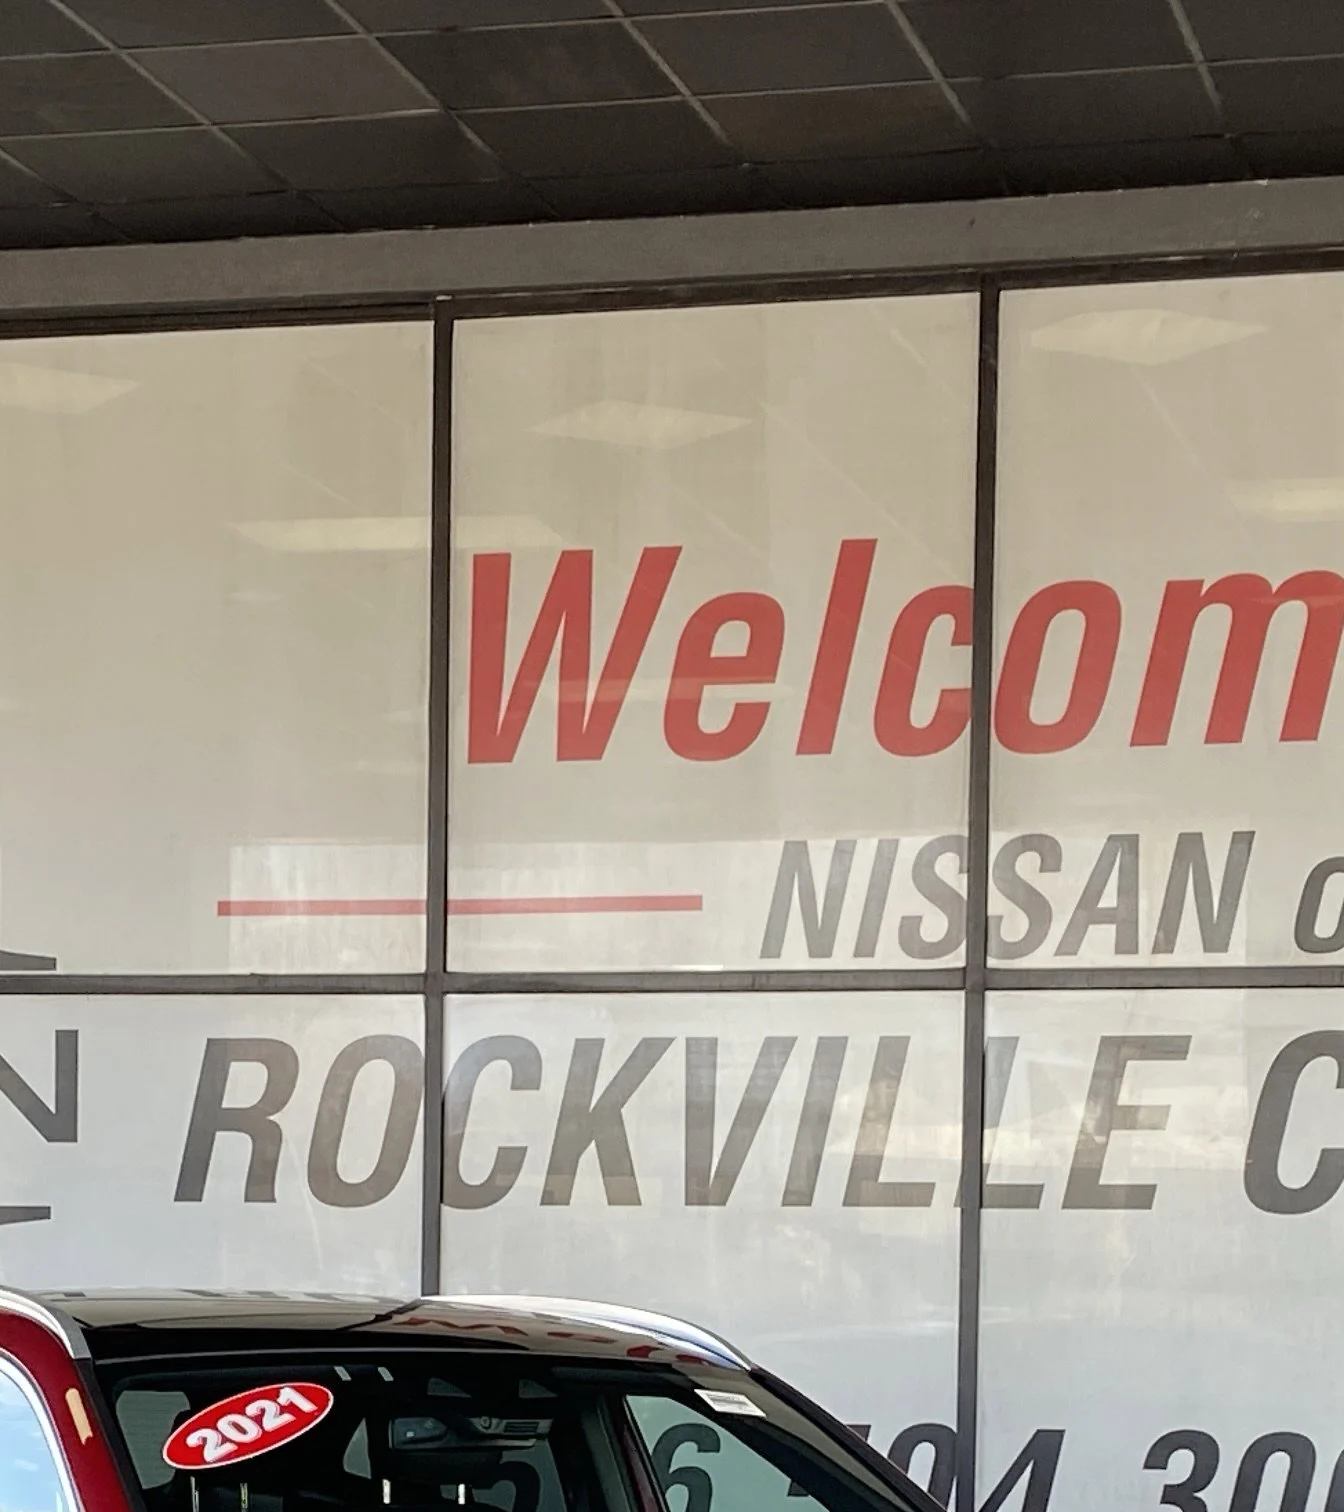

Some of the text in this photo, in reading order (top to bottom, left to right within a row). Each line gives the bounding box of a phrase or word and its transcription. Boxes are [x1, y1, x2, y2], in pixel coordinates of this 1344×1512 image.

[760, 831, 1254, 960] NISSAN
[173, 1034, 1190, 1211] ROCKVILLE
[186, 1386, 317, 1462] 2021
